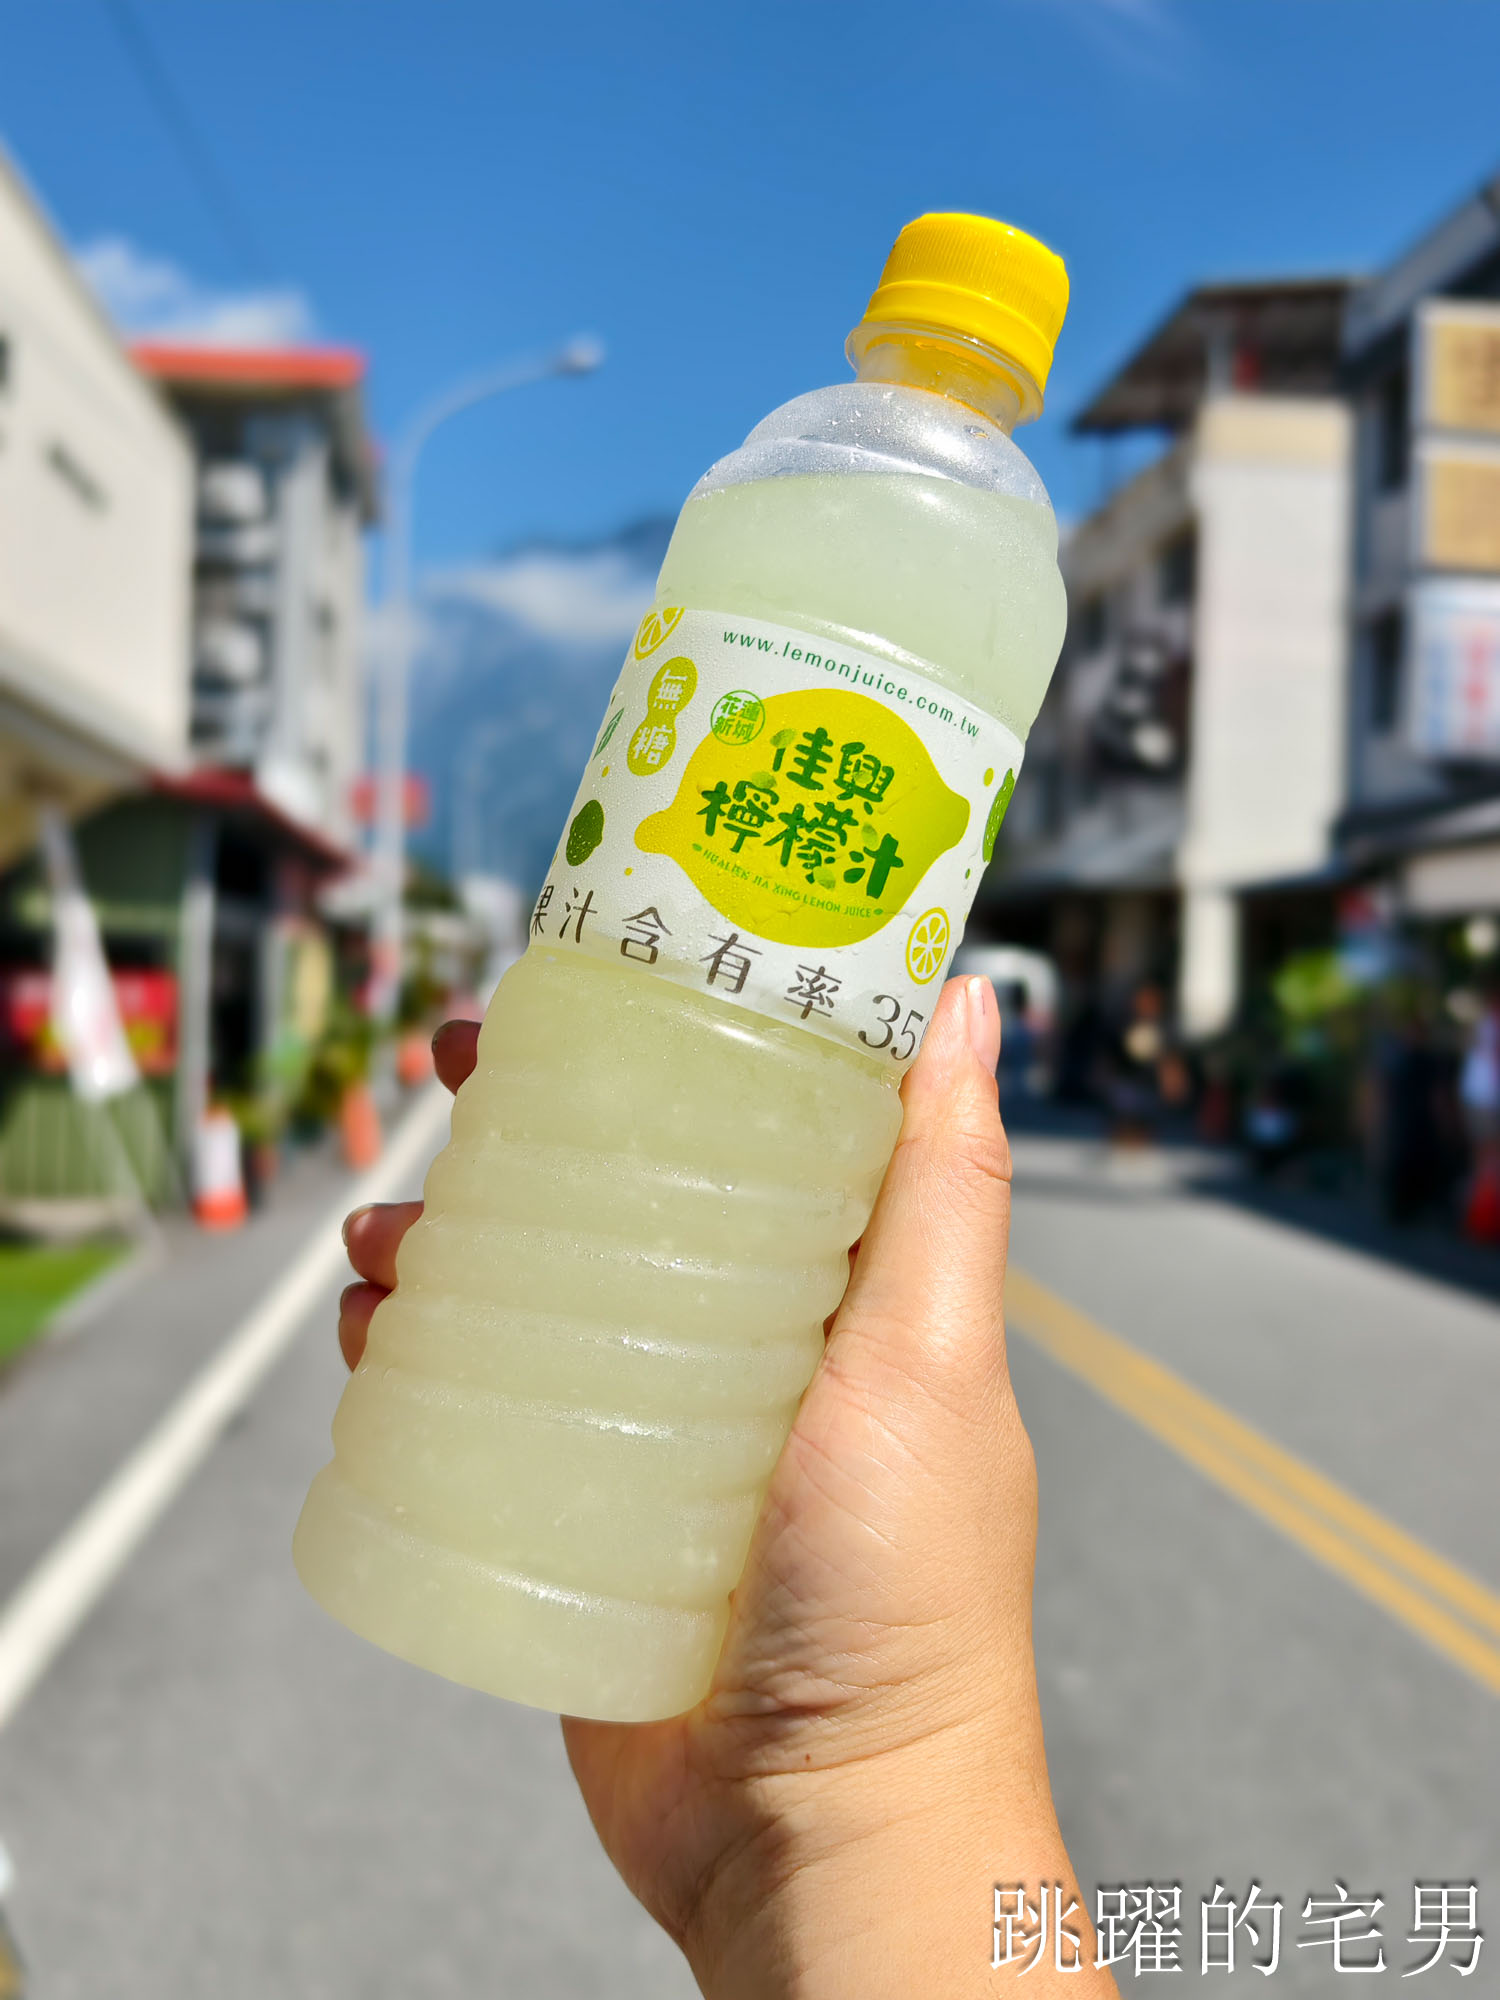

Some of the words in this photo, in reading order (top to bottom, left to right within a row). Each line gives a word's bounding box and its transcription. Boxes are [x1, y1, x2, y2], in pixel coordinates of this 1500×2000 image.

[633, 669, 688, 766] 無糖
[720, 695, 760, 722] 花蓮
[723, 631, 980, 738] www.lemonjuice.com.tw
[770, 727, 895, 816] 佳興
[696, 781, 904, 900] 檸檬汁
[753, 875, 769, 890] JIA
[772, 882, 801, 902] XING
[803, 894, 842, 914] LEMON
[844, 905, 872, 919] JUICE
[531, 885, 930, 1061] 果汁含有率35
